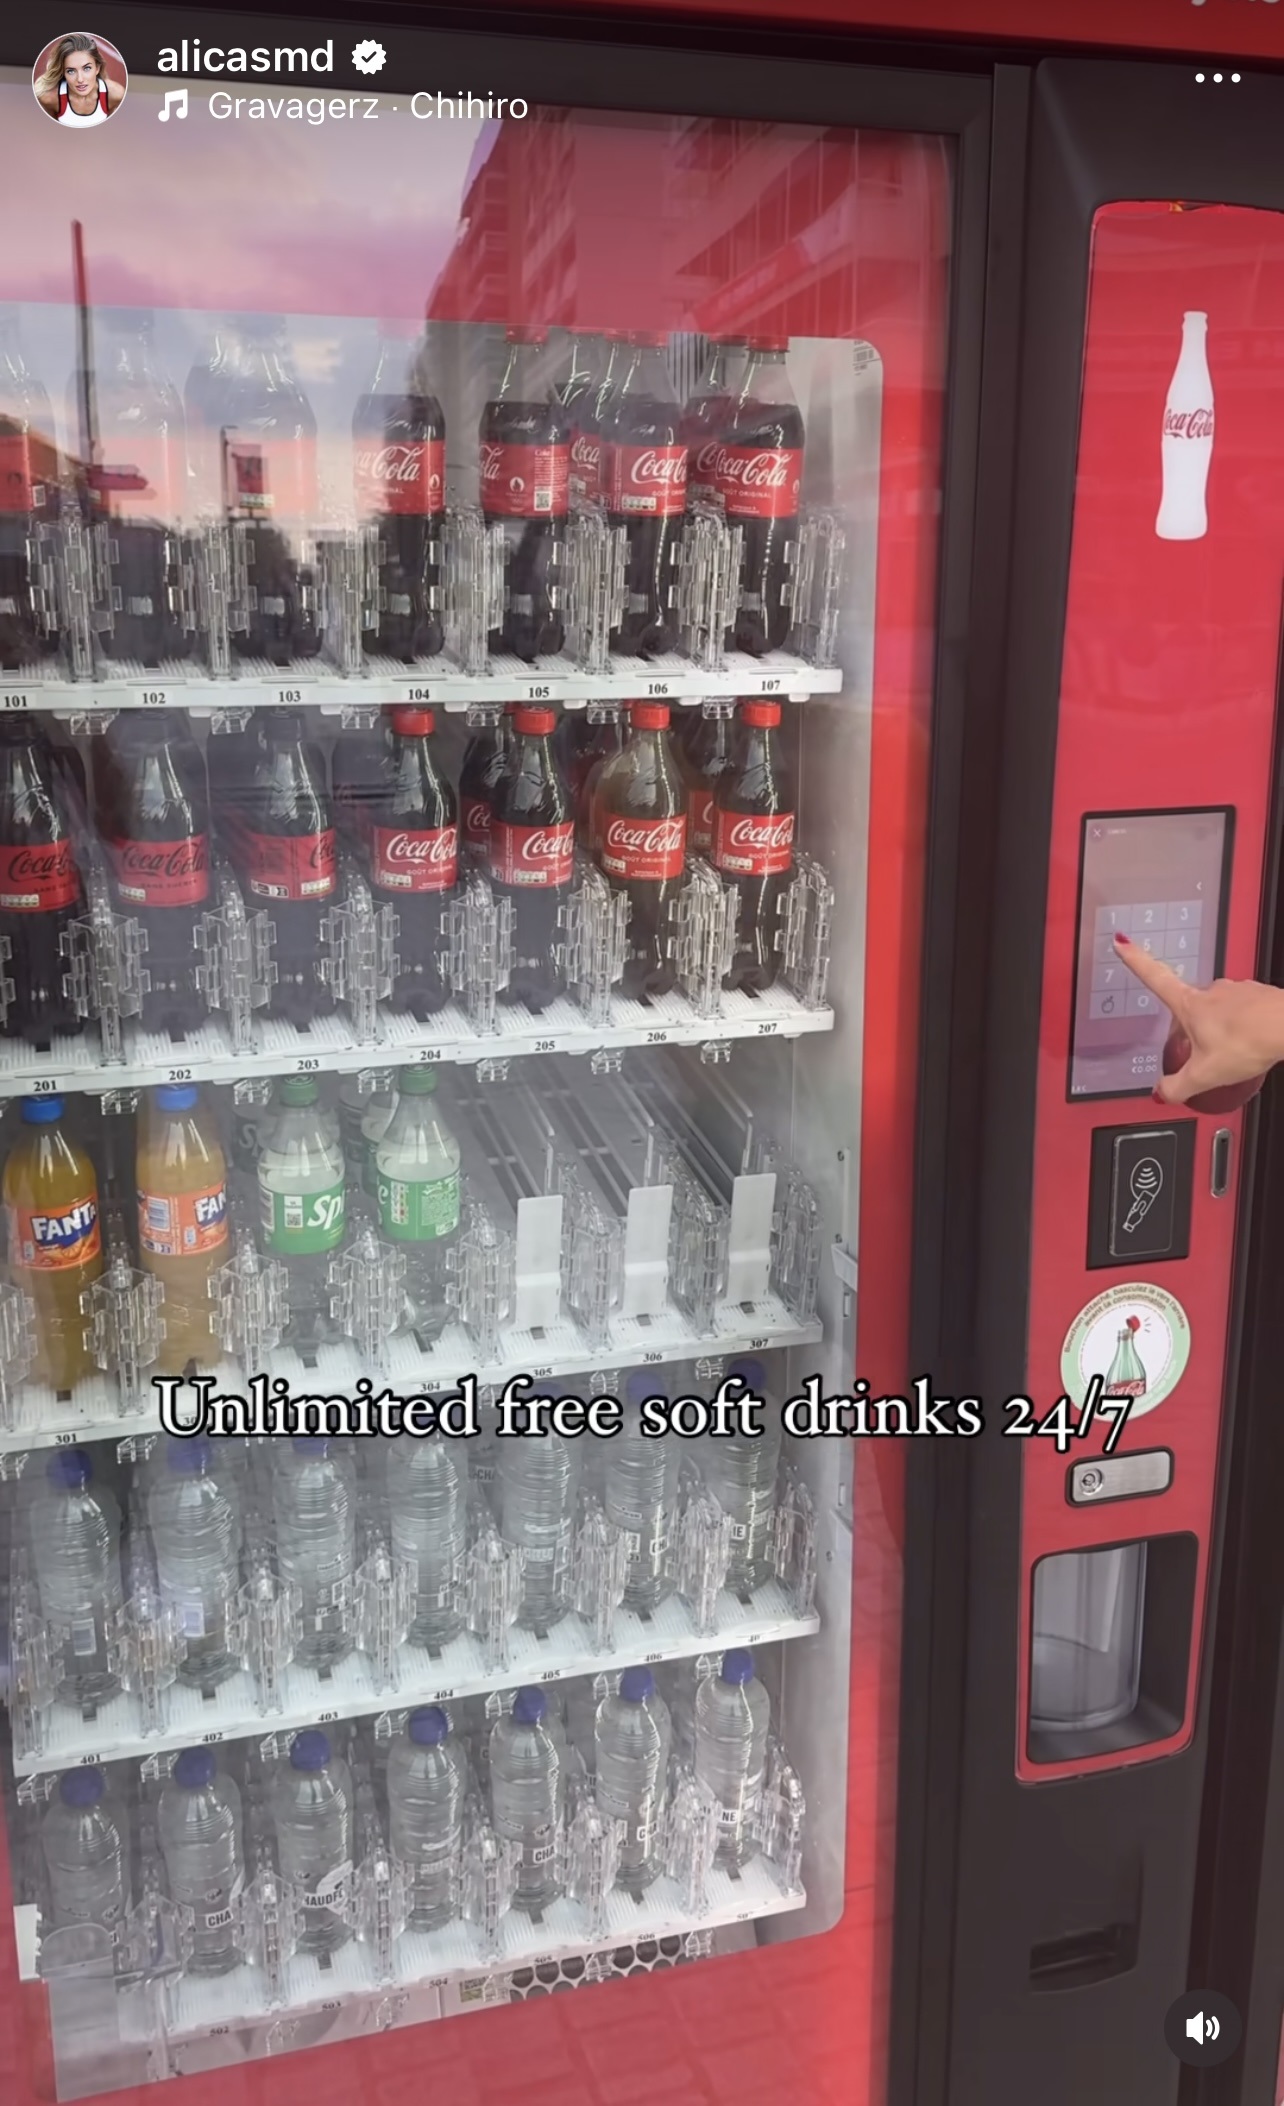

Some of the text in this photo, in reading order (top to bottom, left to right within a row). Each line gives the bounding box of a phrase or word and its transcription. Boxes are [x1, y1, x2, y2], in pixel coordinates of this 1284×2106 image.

[715, 448, 793, 487] Coca-Cola
[648, 683, 668, 695] 106
[760, 680, 781, 691] 107
[142, 692, 166, 704] 102
[278, 691, 301, 703] 103
[408, 689, 430, 701] 104
[528, 687, 550, 699] 105
[4, 695, 27, 708] 101
[608, 820, 683, 852] Coca-Cola
[1145, 909, 1153, 923] 2
[1180, 907, 1188, 920] 3
[1144, 936, 1186, 952] 5 6
[1105, 969, 1114, 983] 7
[1137, 995, 1149, 1007] 0
[758, 1023, 778, 1034] 207
[646, 1031, 667, 1042] 206
[535, 1040, 556, 1051] 205
[420, 1050, 441, 1061] 204
[297, 1060, 320, 1071] 203
[168, 1069, 192, 1081] 202
[33, 1080, 57, 1093] 201
[31, 1201, 96, 1241] FANTA
[749, 1339, 770, 1349] 307
[643, 1352, 663, 1363] 306
[533, 1367, 553, 1377] 305
[420, 1382, 441, 1393] 304
[55, 1433, 77, 1445] 301
[644, 1653, 663, 1662] 406
[541, 1670, 561, 1681] 405
[434, 1690, 454, 1700] 404
[318, 1711, 339, 1722] 403
[202, 1732, 224, 1743] 402
[80, 1755, 101, 1765] 401
[429, 1978, 449, 1988] 504
[209, 2026, 230, 2036] 502
